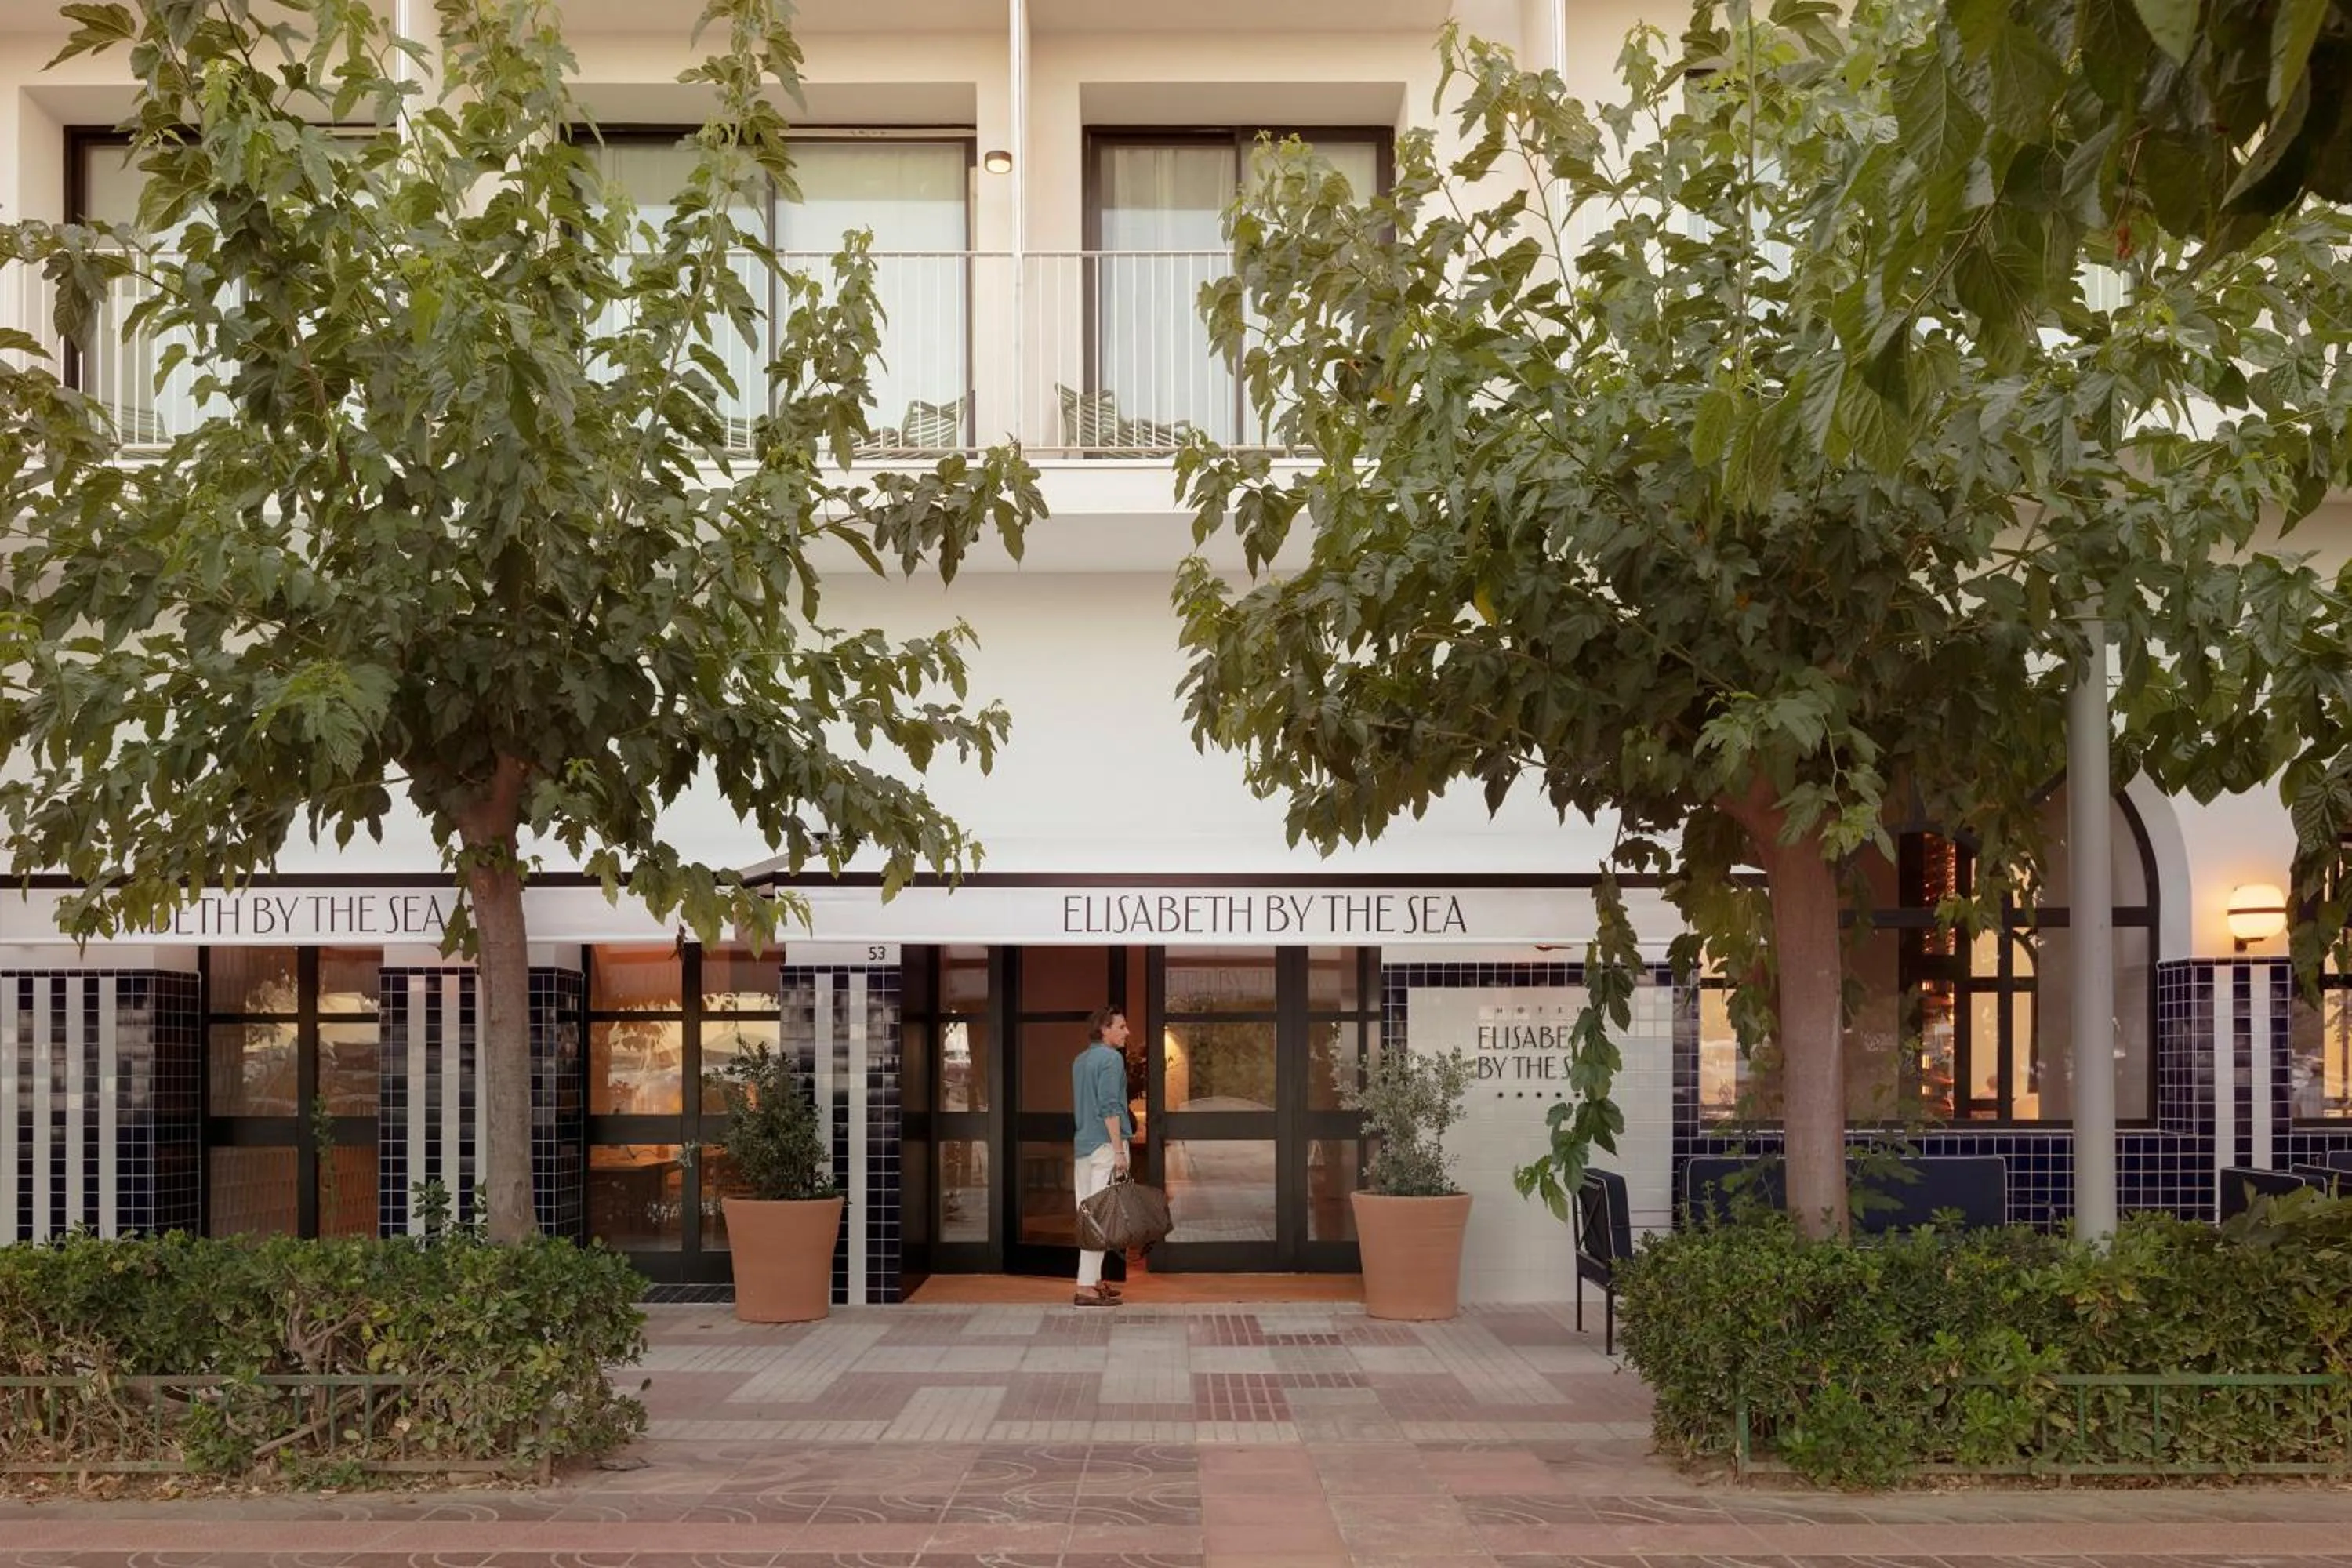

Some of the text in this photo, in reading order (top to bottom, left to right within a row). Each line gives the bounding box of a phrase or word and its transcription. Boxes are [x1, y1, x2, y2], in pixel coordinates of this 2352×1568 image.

[253, 896, 298, 933] BY
[306, 896, 376, 932] THE
[385, 895, 445, 935] SEA
[1064, 895, 1467, 933] ELISABETH BY THE SEA
[868, 946, 885, 960] 53
[1478, 1056, 1508, 1080] BY
[1512, 1056, 1557, 1080] THE
